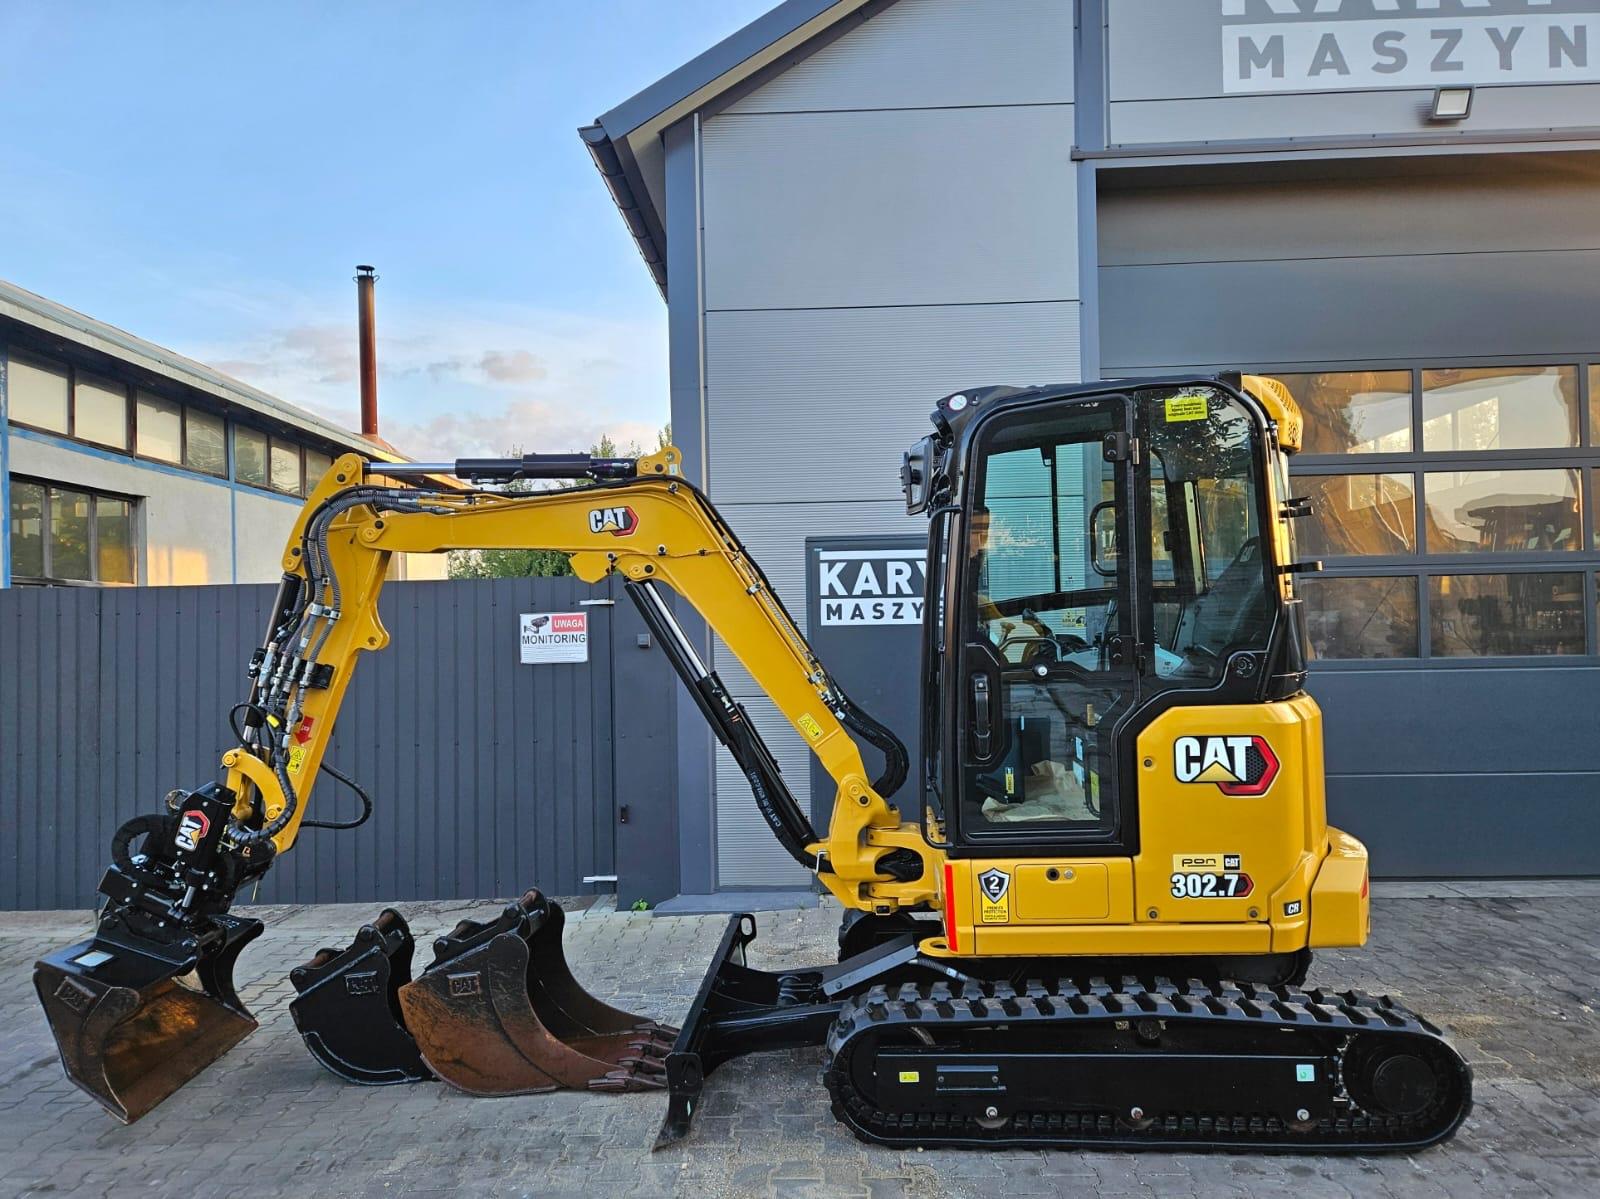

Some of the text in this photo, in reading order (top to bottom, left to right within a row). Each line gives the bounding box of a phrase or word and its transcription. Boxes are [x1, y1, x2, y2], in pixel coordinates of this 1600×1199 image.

[1238, 25, 1588, 80] MASZYN
[589, 507, 626, 533] CAT
[554, 619, 583, 628] UWAGA
[522, 633, 586, 645] MONITORING
[1175, 737, 1252, 782] CAT
[176, 816, 202, 850] CAT
[1182, 858, 1240, 867] pon CAT
[990, 876, 1000, 890] 2
[1171, 873, 1239, 897] 302.7
[1288, 902, 1300, 915] CR
